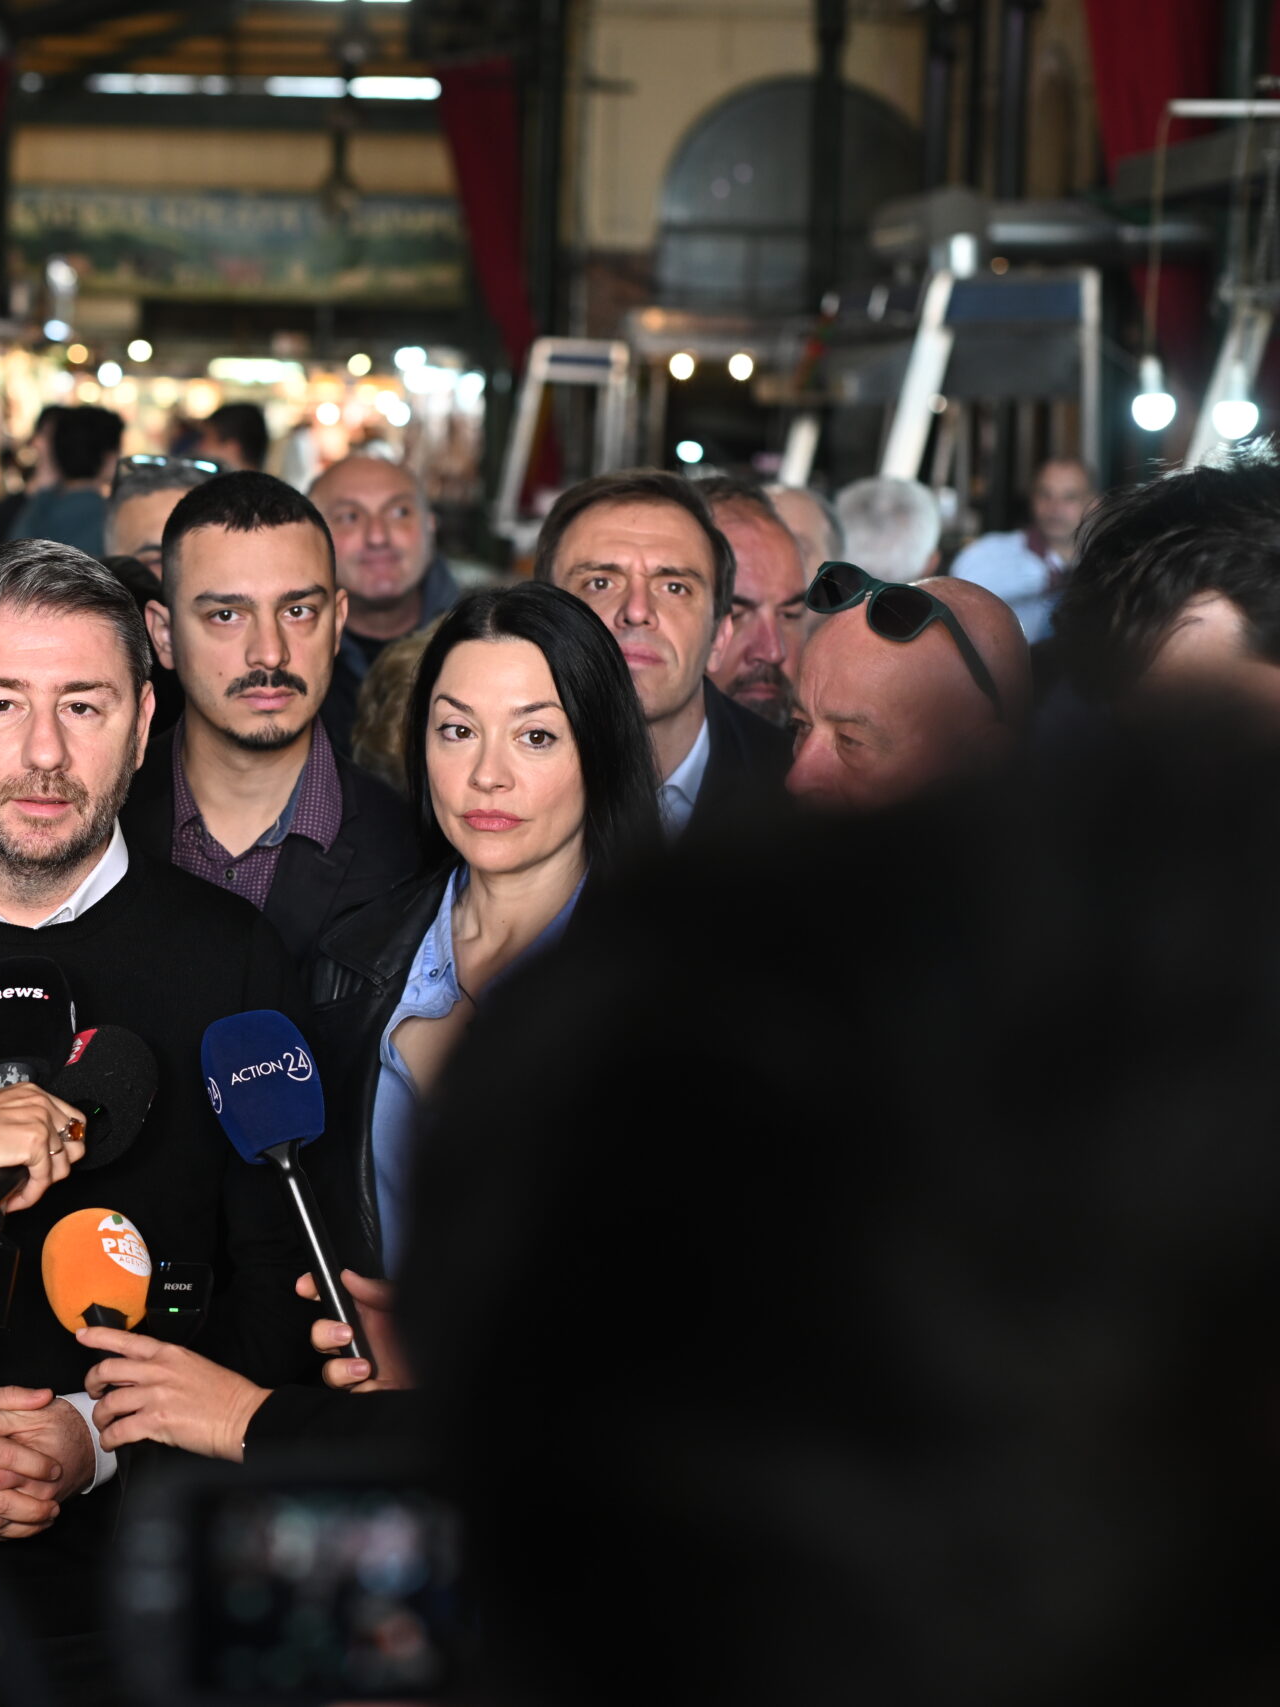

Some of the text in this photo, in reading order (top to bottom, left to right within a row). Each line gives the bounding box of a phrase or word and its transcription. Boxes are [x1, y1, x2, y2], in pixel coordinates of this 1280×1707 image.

[231, 1050, 310, 1086] ACTION 24
[101, 1238, 149, 1262] PRES
[164, 1283, 193, 1291] RØDE
